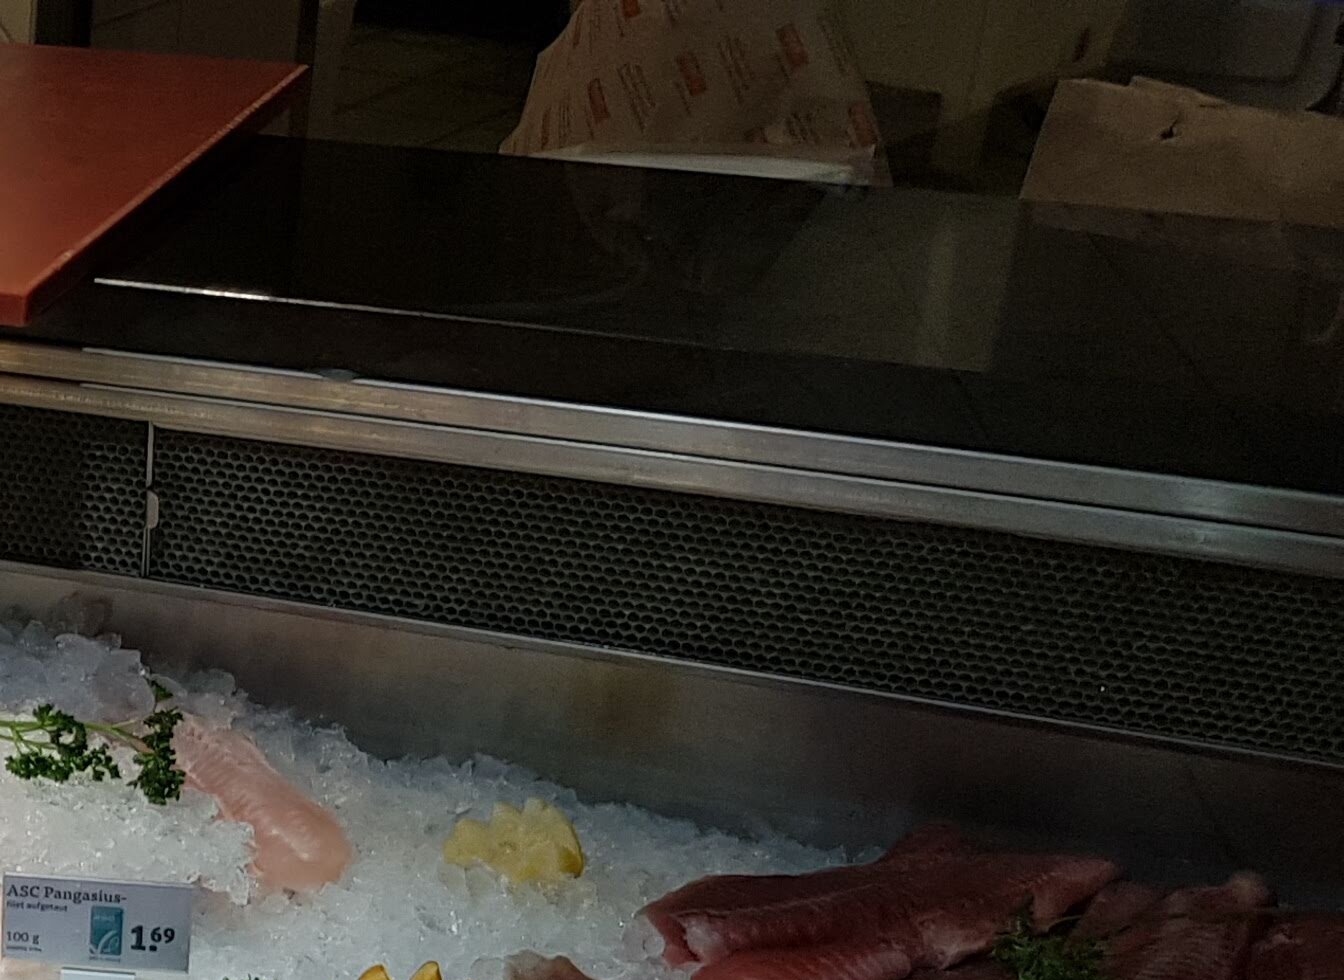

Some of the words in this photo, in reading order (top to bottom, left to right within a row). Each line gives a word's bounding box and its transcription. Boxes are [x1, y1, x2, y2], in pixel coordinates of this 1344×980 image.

[6, 884, 40, 898] ASC
[44, 887, 127, 904] Pangasius-
[7, 931, 29, 942] 100
[32, 934, 40, 945] g
[131, 925, 175, 951] 1.69
